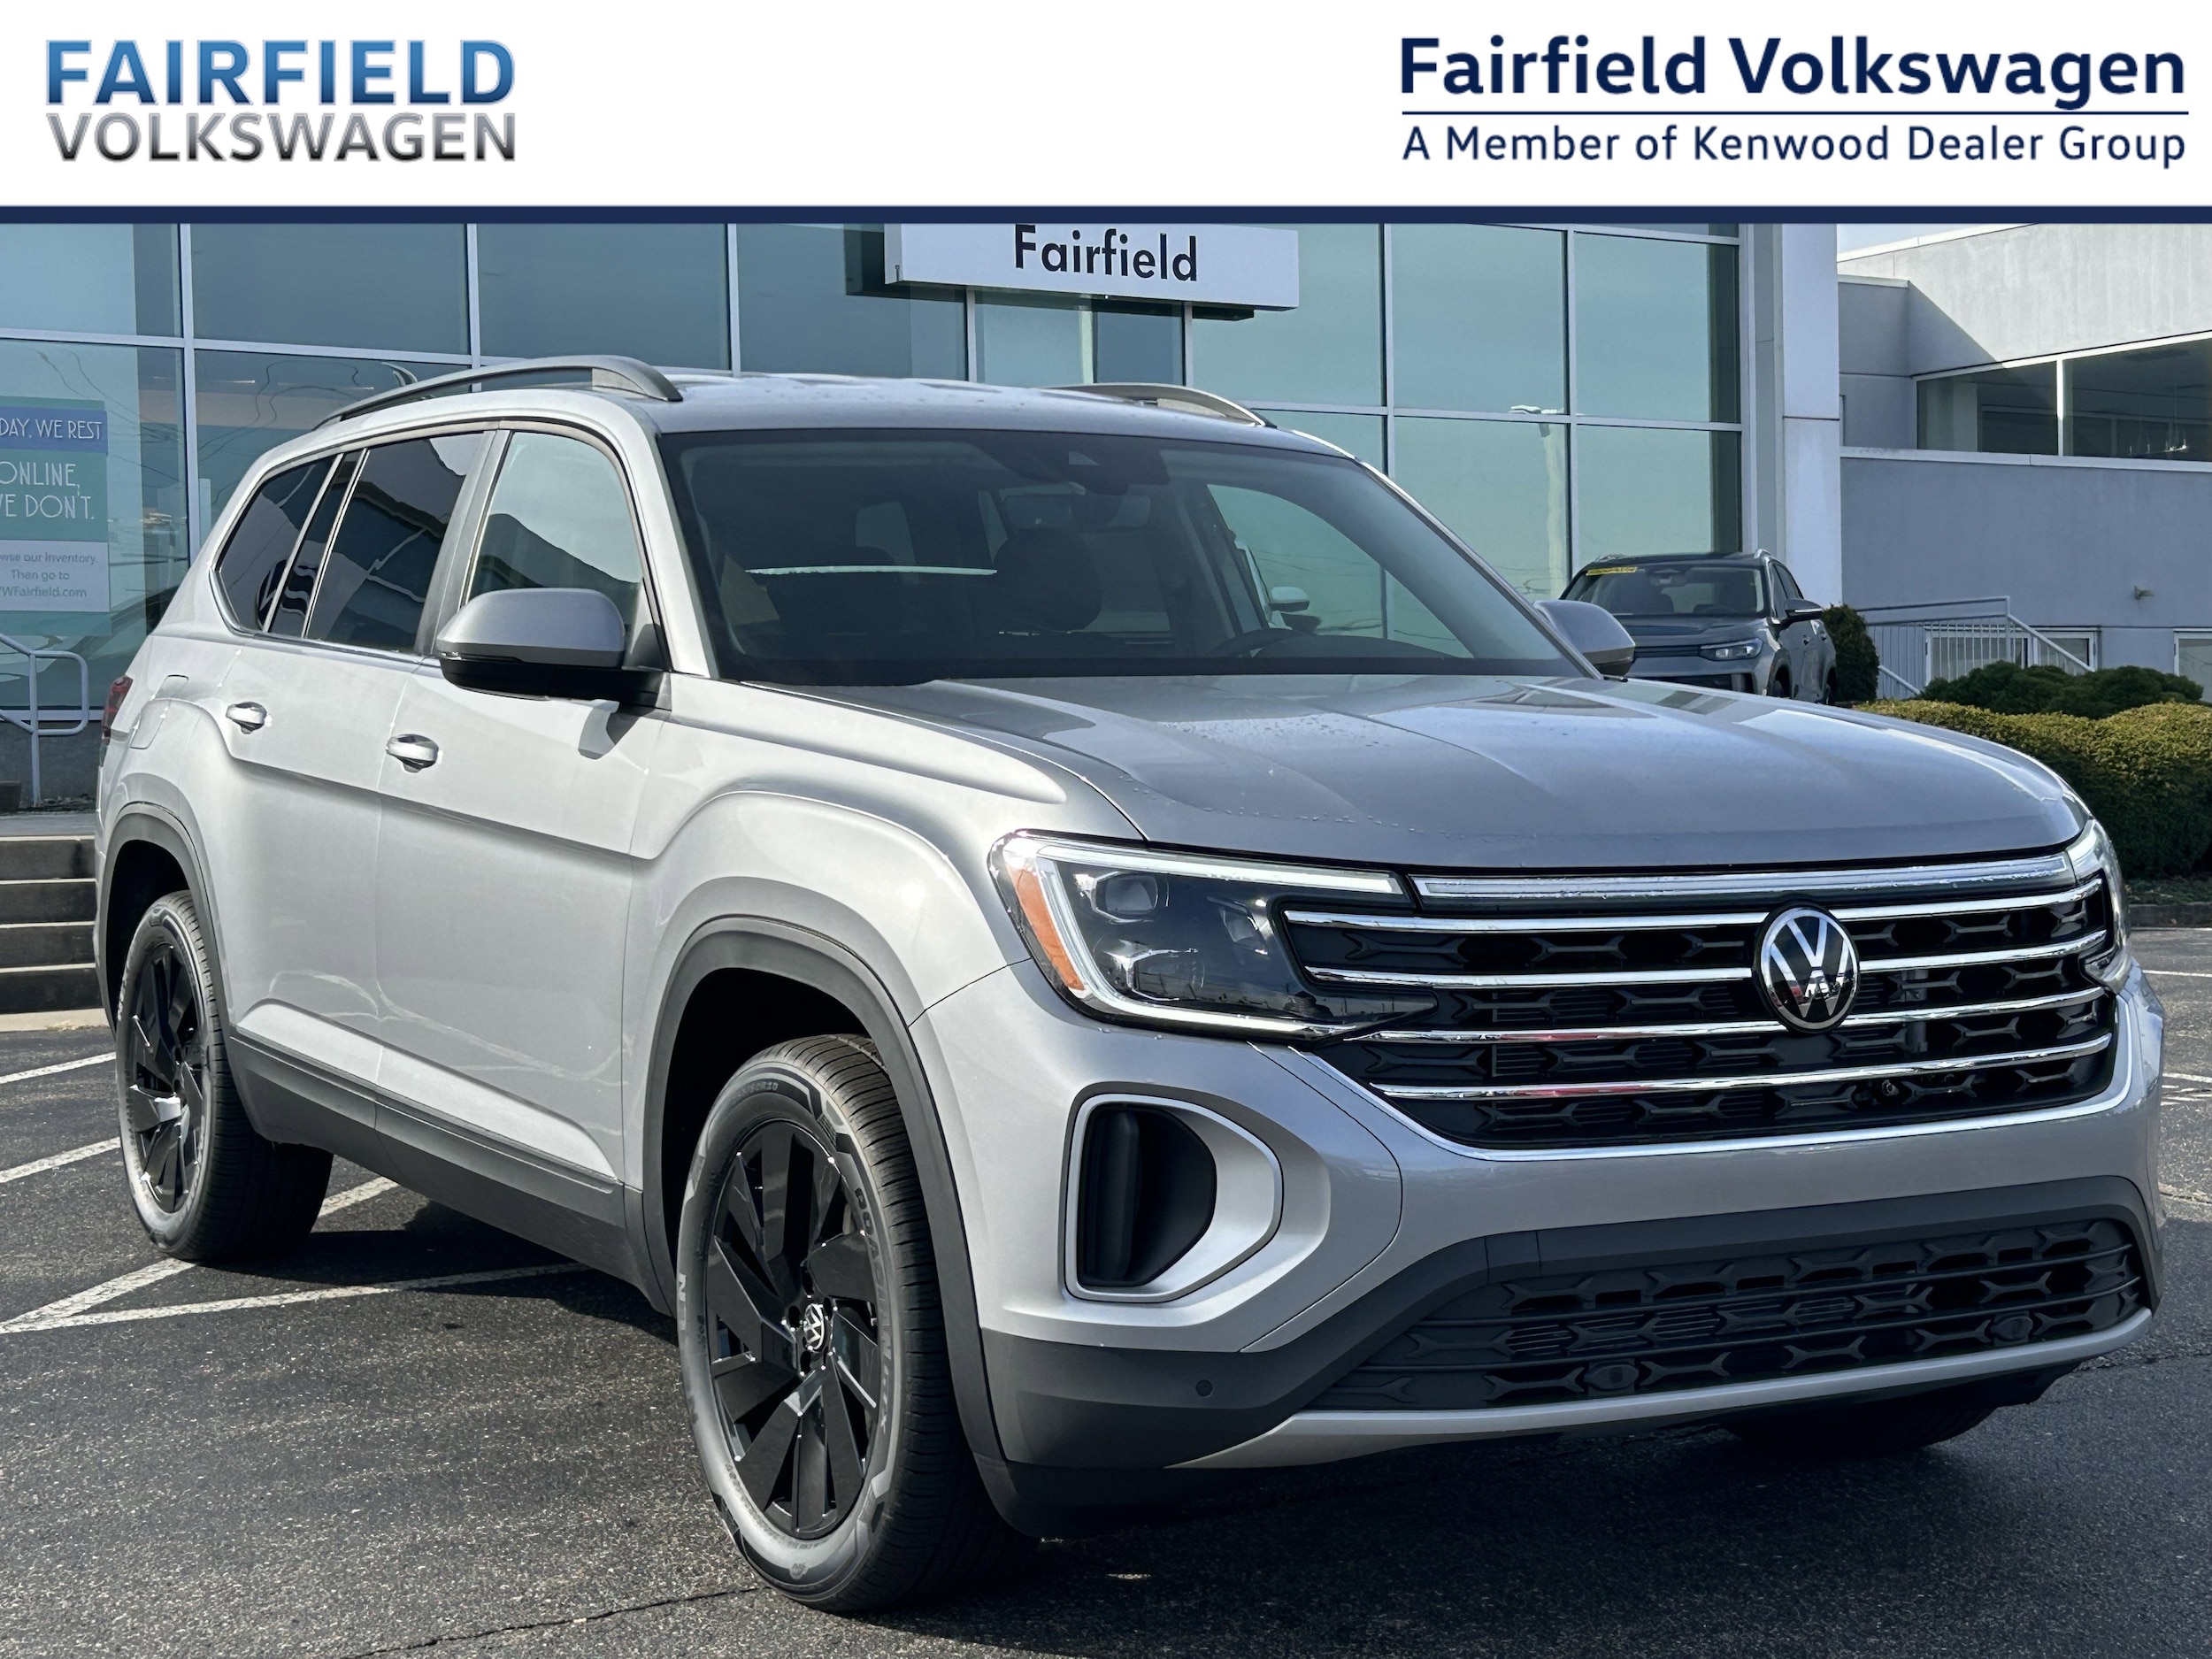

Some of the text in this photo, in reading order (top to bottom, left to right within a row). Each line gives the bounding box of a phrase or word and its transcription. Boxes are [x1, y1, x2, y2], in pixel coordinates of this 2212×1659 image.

[1015, 224, 1197, 281] Fairfield
[35, 419, 63, 438] WE
[67, 420, 103, 440] REST
[25, 490, 95, 519] DON'T.
[11, 569, 39, 580] Then
[41, 572, 55, 582] go
